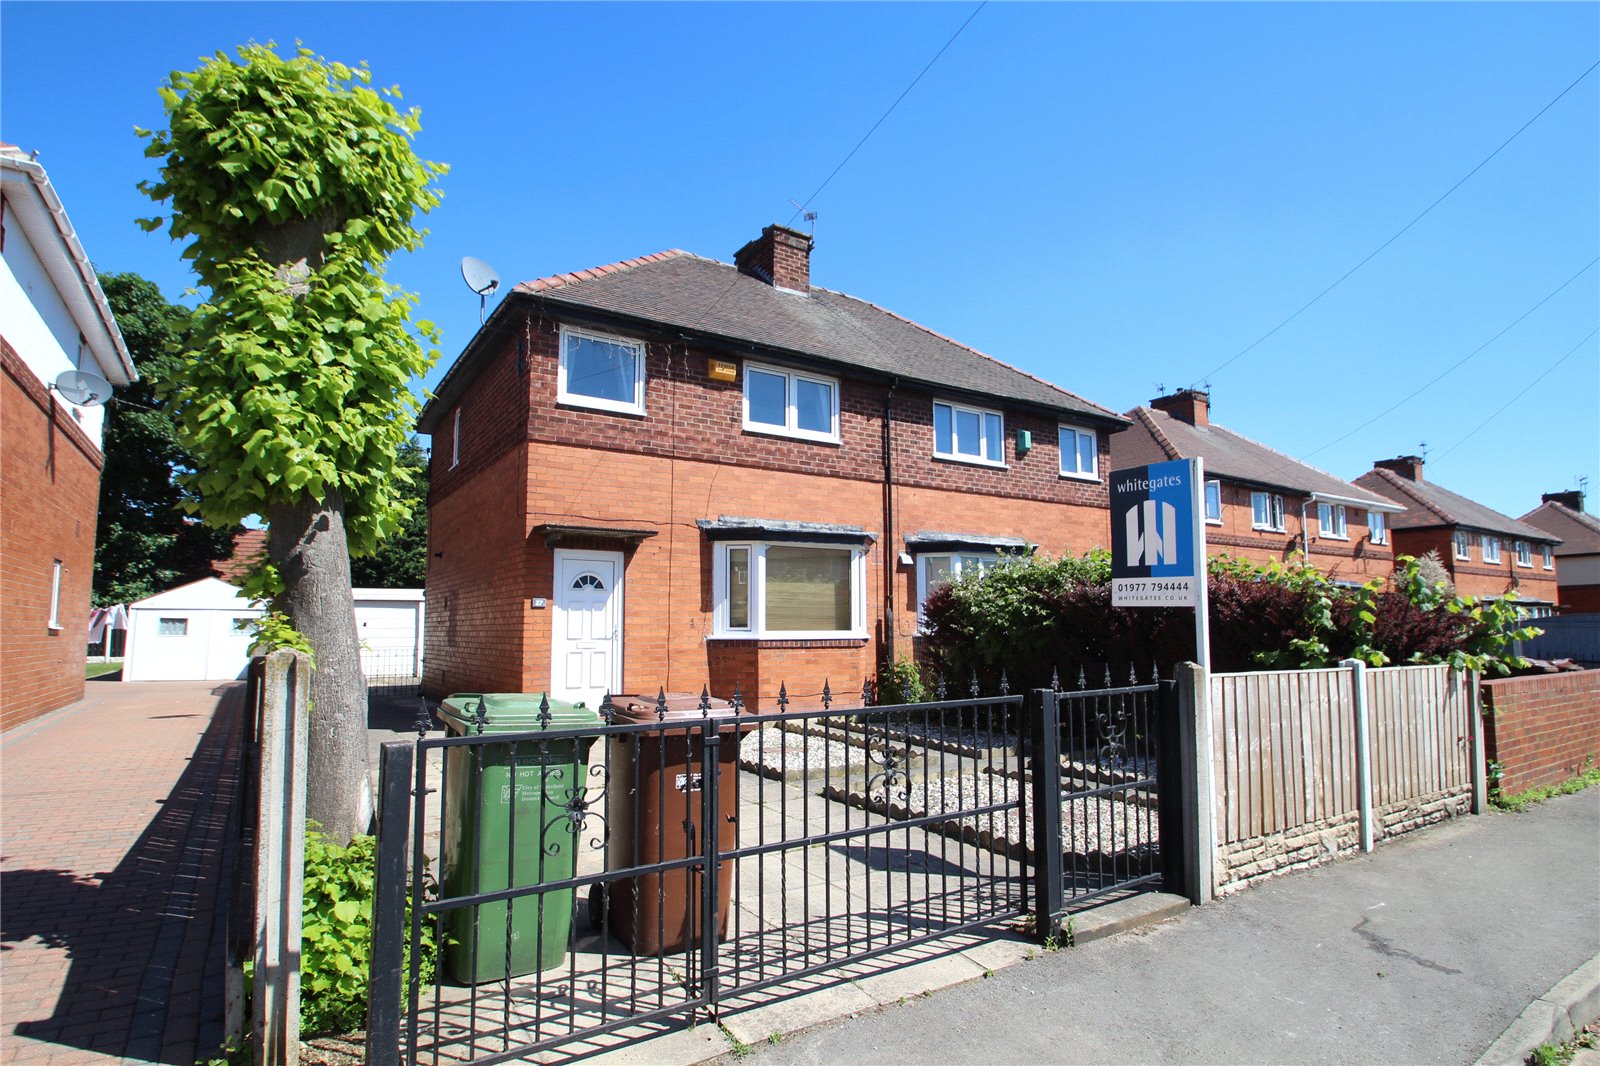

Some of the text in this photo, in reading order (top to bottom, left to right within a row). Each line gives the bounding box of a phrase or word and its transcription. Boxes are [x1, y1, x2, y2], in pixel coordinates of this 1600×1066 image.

[1117, 475, 1182, 493] whitegates
[1117, 582, 1189, 592] 01977 794444
